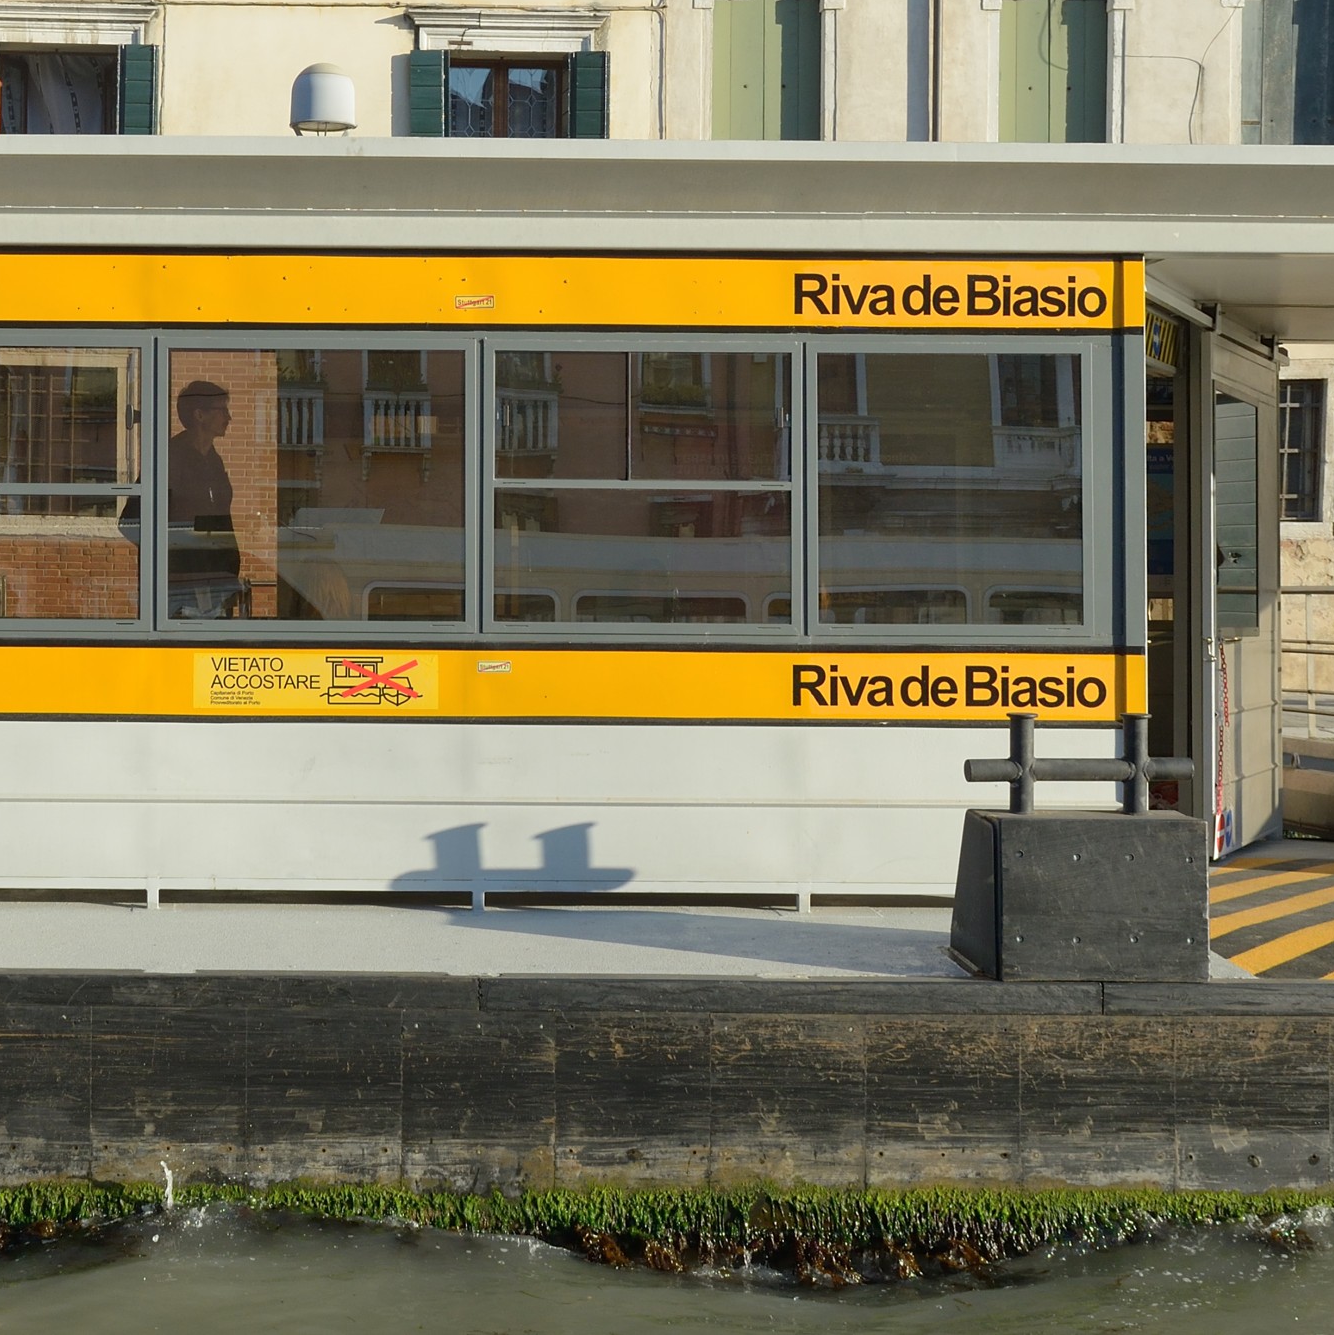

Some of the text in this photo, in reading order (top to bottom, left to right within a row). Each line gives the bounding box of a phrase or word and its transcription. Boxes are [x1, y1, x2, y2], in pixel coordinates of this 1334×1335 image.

[794, 273, 1107, 318] Riva de Biasio
[211, 657, 284, 672] VIETATO
[210, 674, 321, 689] ACCOSTARE
[792, 664, 1107, 708] Riva de Biasio
